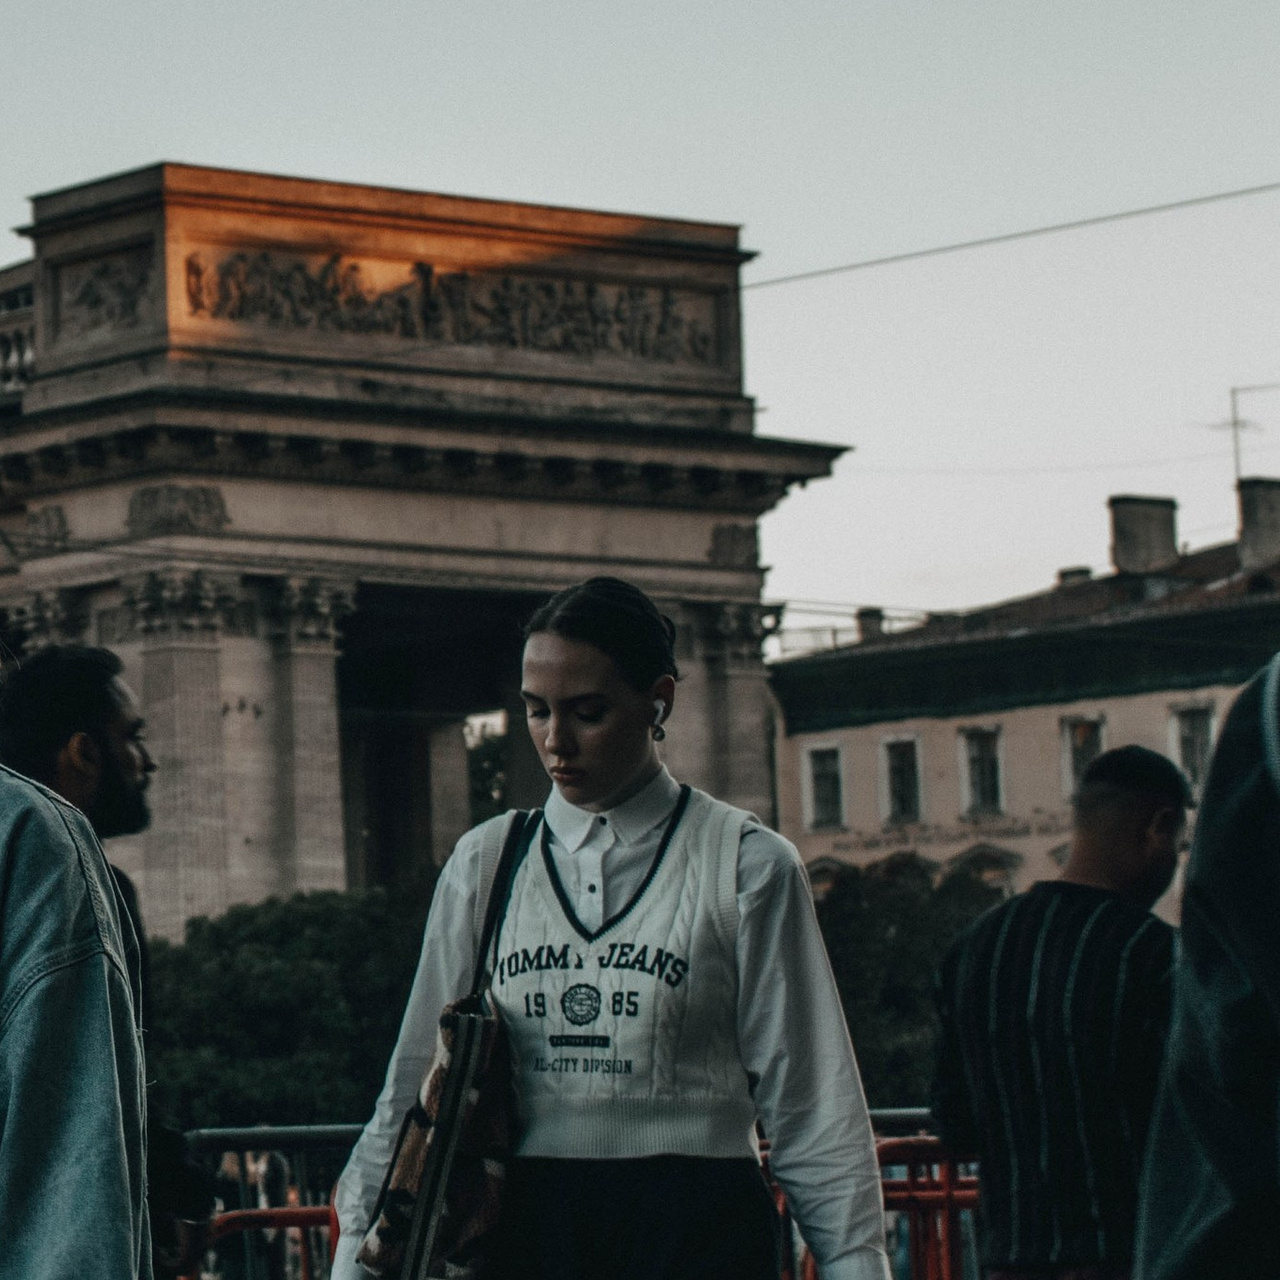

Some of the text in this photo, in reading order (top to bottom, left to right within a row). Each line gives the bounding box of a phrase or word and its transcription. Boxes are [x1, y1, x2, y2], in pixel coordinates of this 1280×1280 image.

[597, 943, 689, 988] JEANS
[524, 991, 547, 1018] 19
[612, 991, 639, 1017] 85
